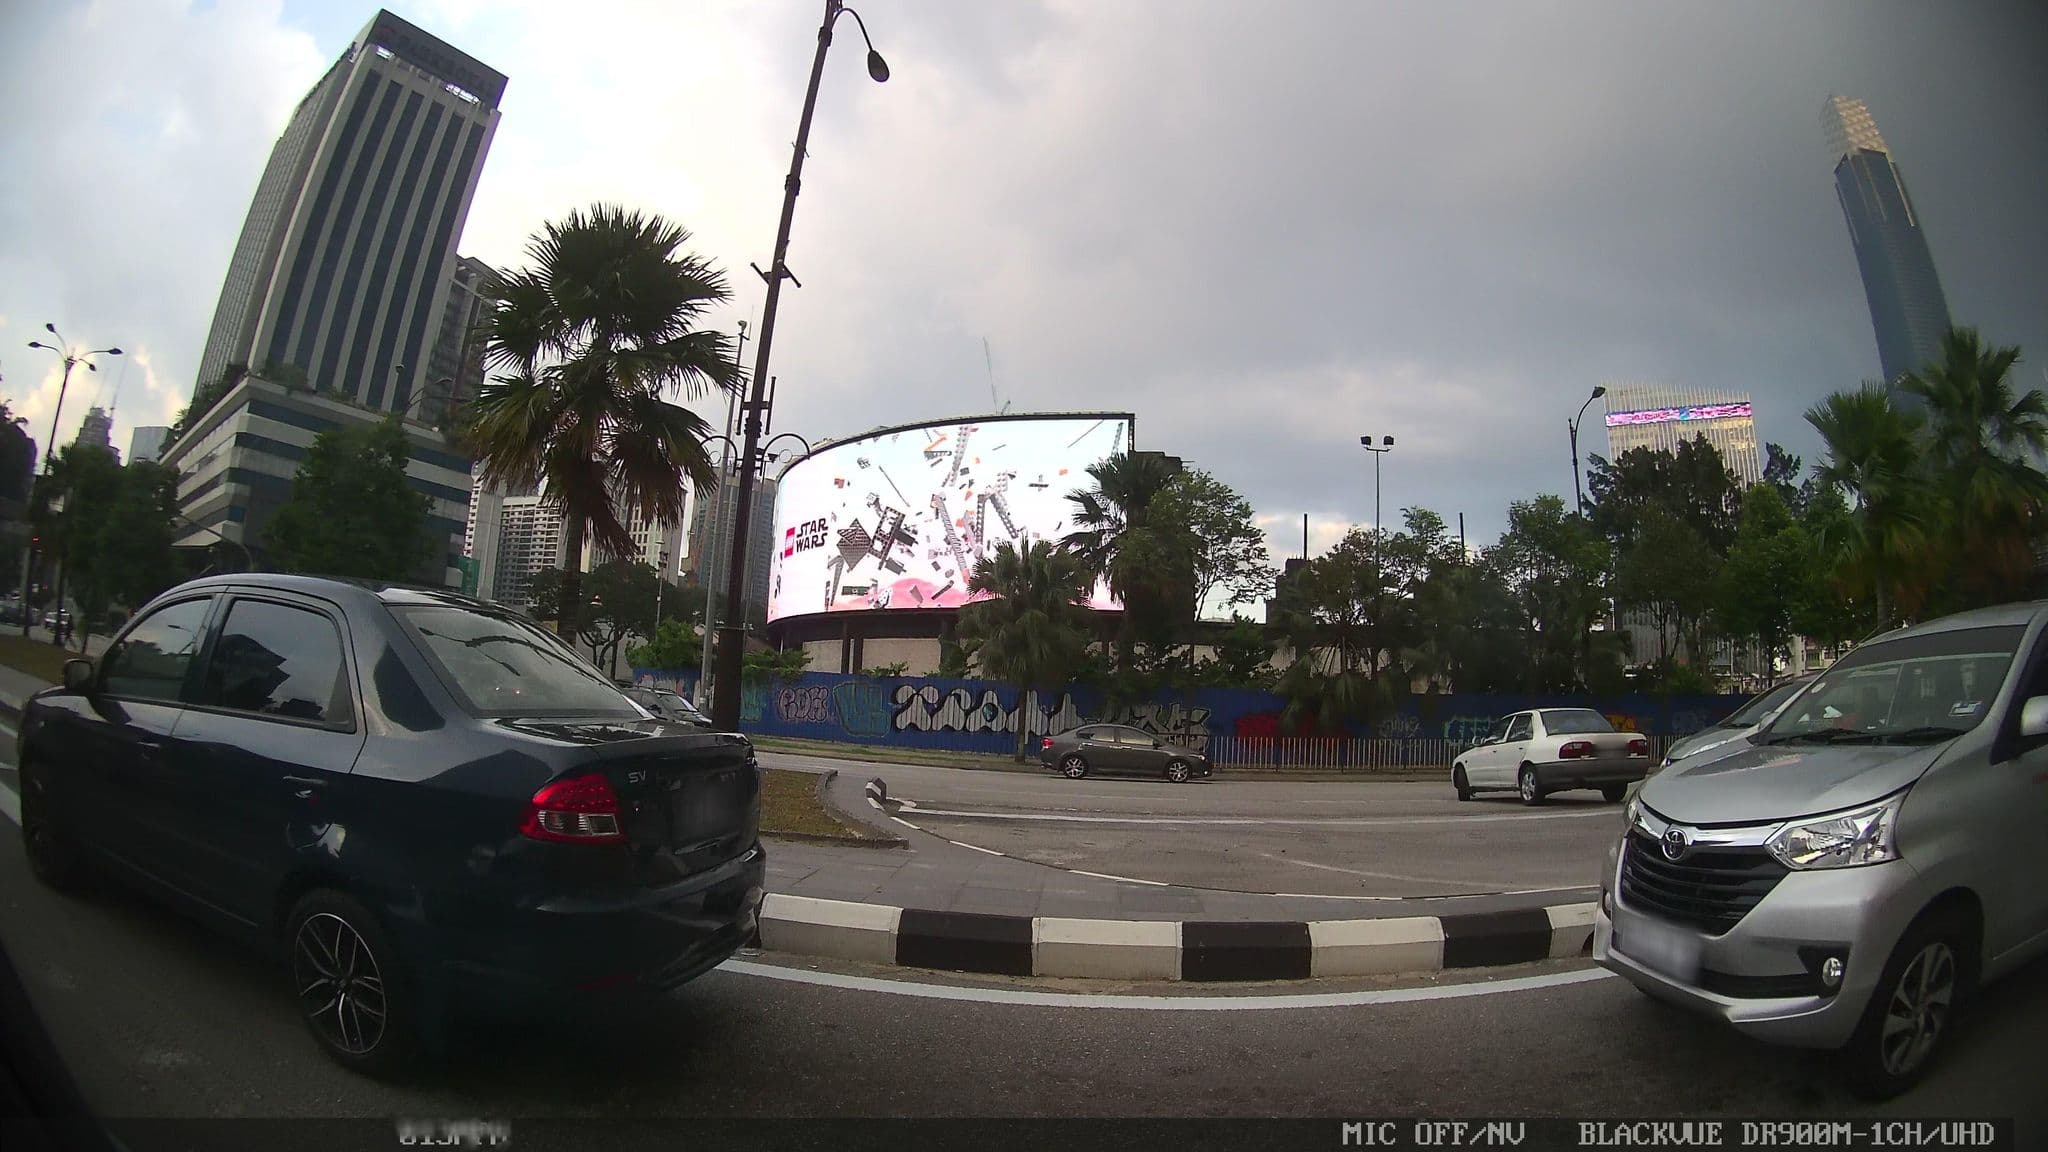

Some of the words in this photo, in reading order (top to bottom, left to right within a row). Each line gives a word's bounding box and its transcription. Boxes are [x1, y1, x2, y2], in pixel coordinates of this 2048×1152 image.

[796, 517, 829, 538] STAR
[795, 532, 828, 553] WARS
[628, 769, 647, 784] SV
